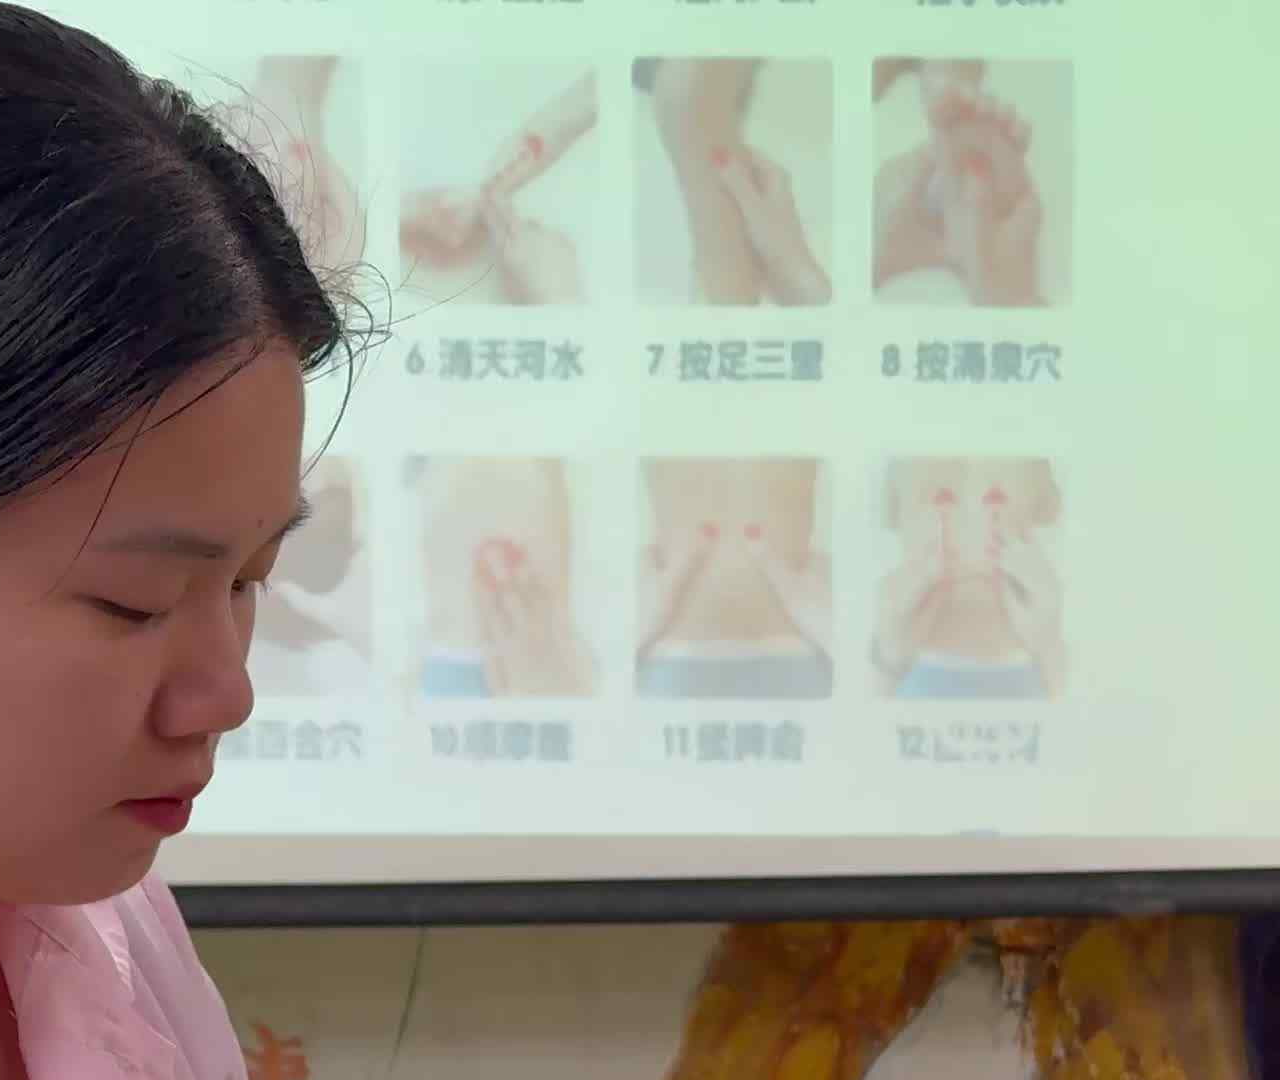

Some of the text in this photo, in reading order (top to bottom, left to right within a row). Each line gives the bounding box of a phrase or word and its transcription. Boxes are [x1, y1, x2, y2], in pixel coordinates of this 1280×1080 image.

[403, 343, 425, 378] 6
[644, 344, 663, 376] 7
[881, 344, 901, 377] 8
